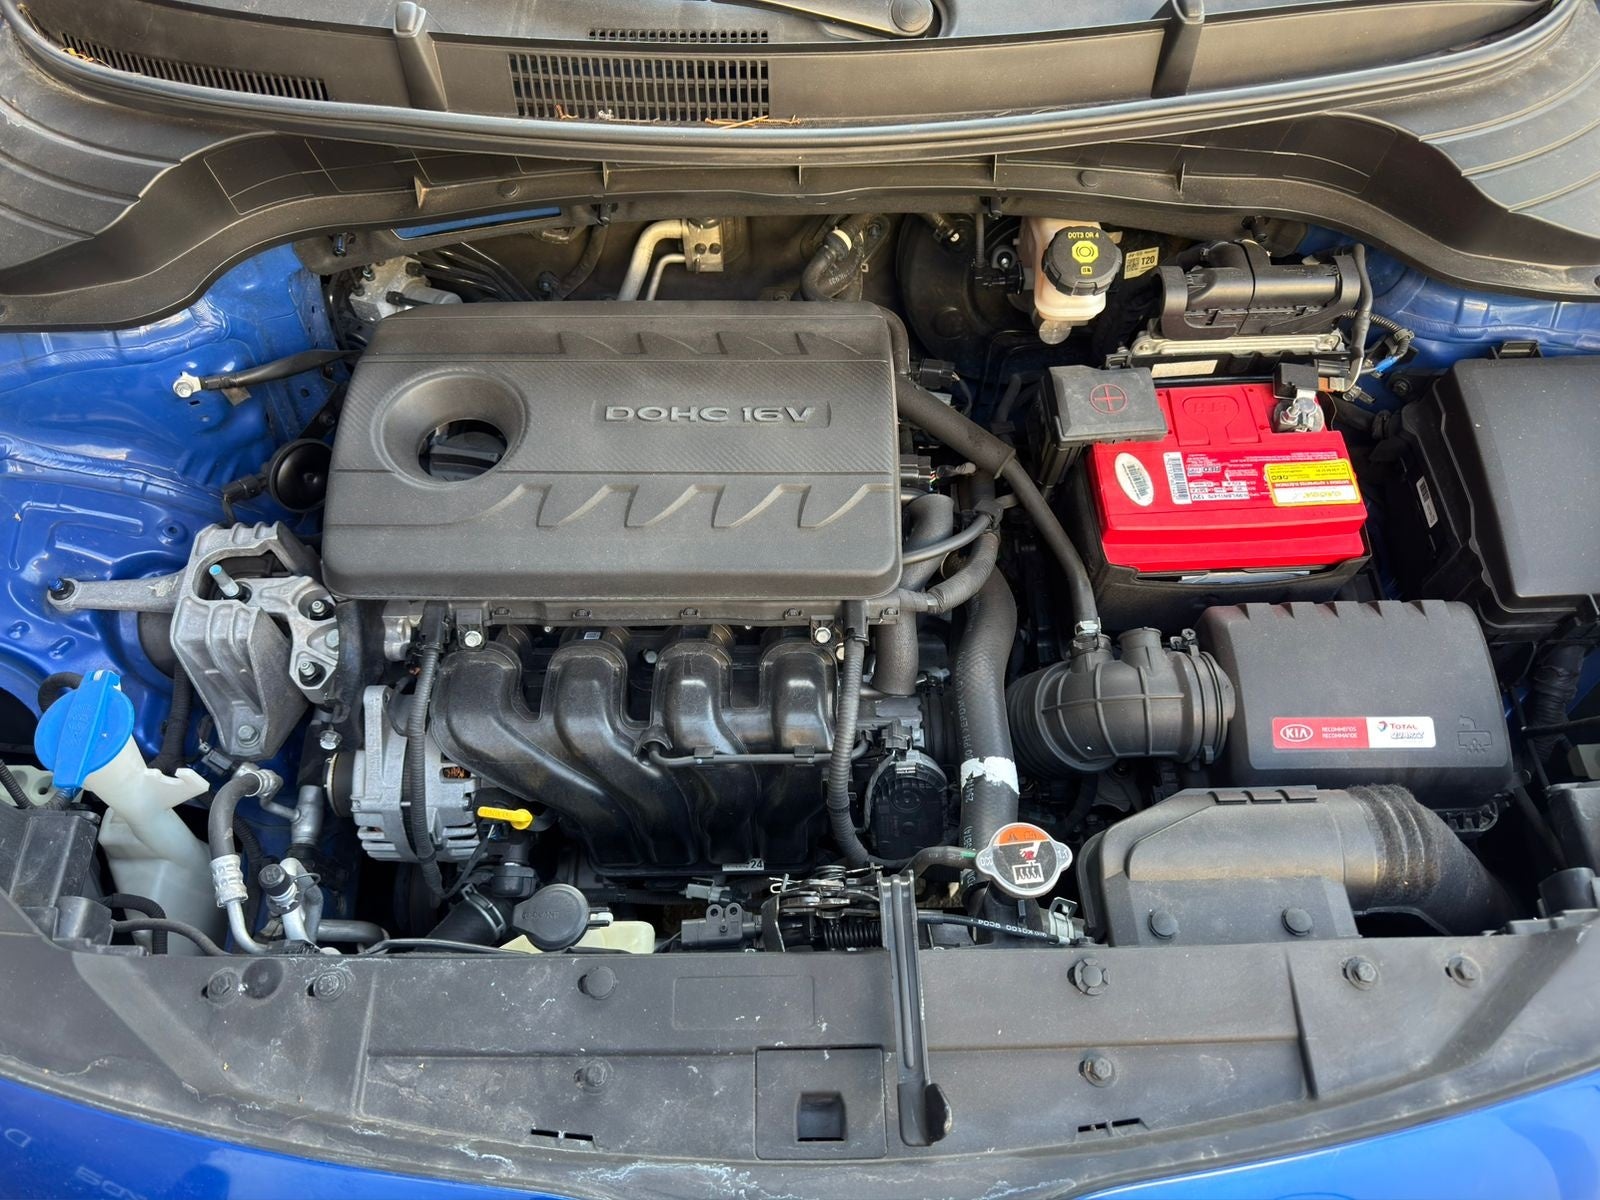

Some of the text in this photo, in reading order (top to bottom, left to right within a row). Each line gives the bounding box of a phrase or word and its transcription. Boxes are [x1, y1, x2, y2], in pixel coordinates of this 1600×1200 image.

[1141, 255, 1155, 265] T20
[605, 406, 816, 422] DOHC 16V
[1285, 729, 1309, 739] KIA
[750, 860, 763, 869] 24
